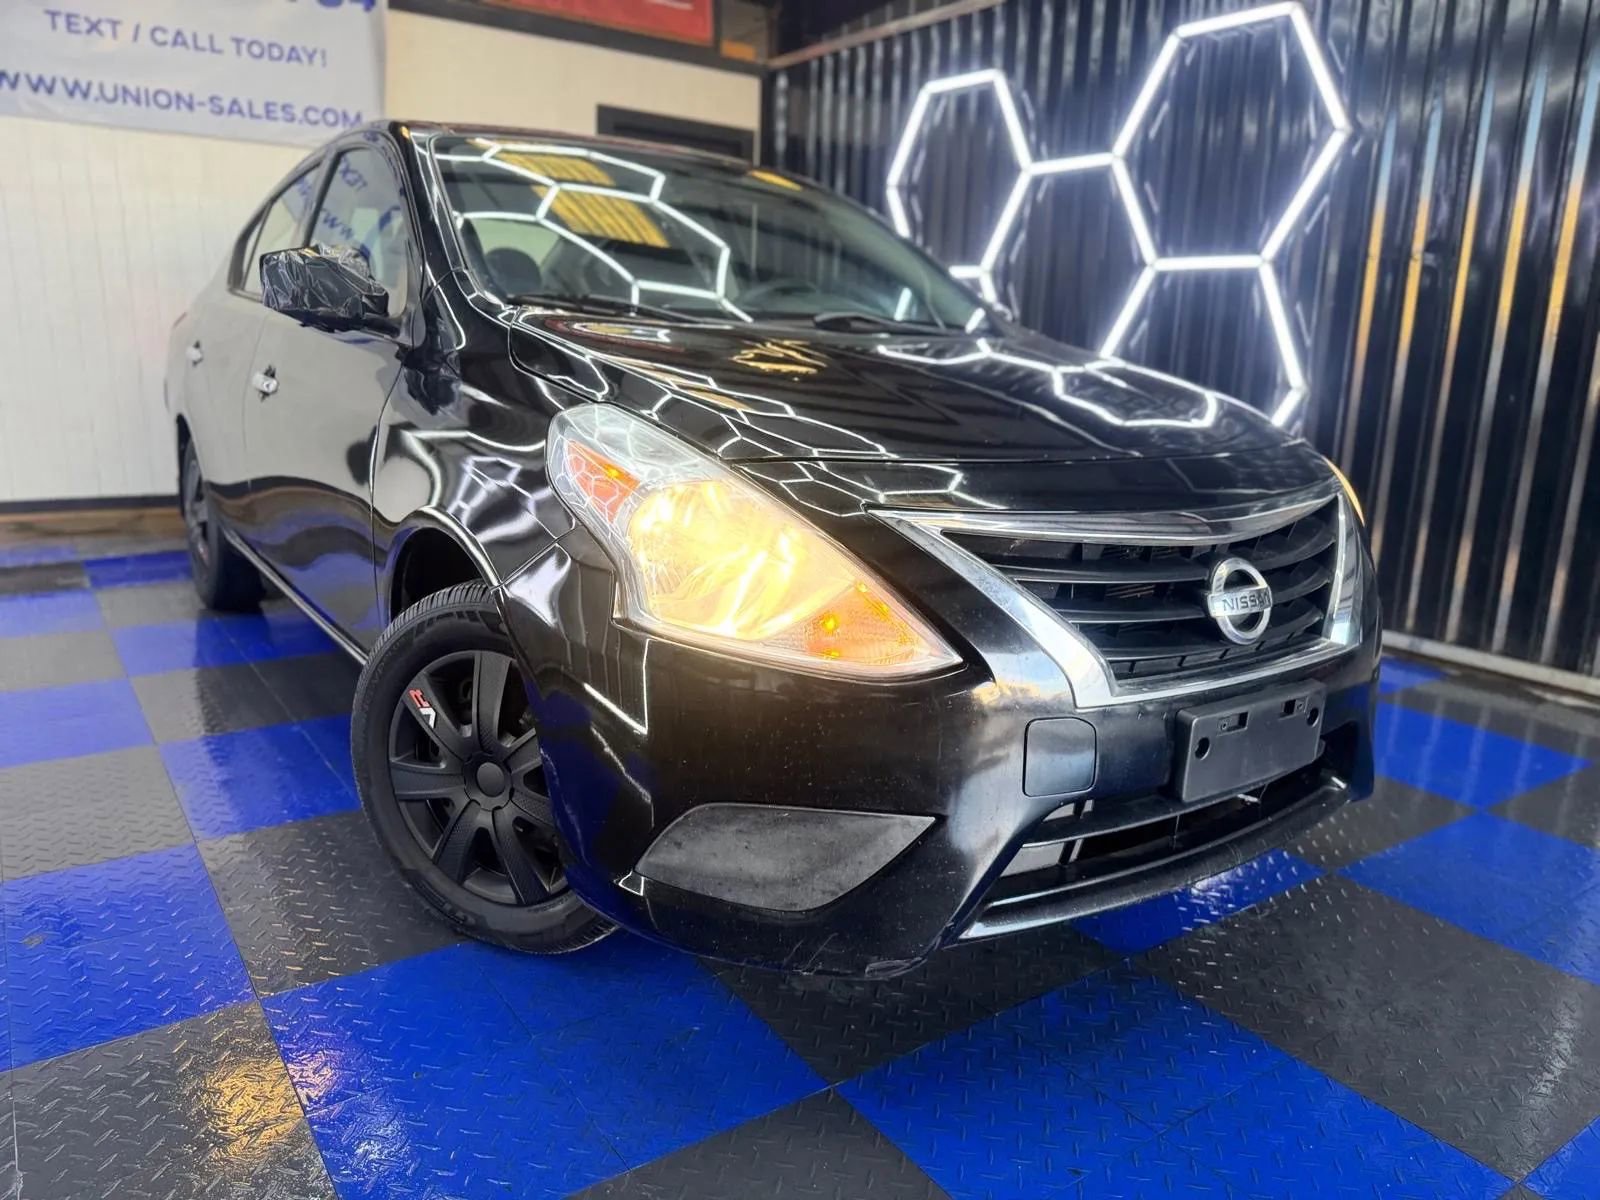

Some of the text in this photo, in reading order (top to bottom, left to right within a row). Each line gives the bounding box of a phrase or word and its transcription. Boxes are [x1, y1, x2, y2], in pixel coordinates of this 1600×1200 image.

[44, 9, 327, 67] TEXT / CALL TODAY!
[1223, 591, 1271, 611] NISSAN
